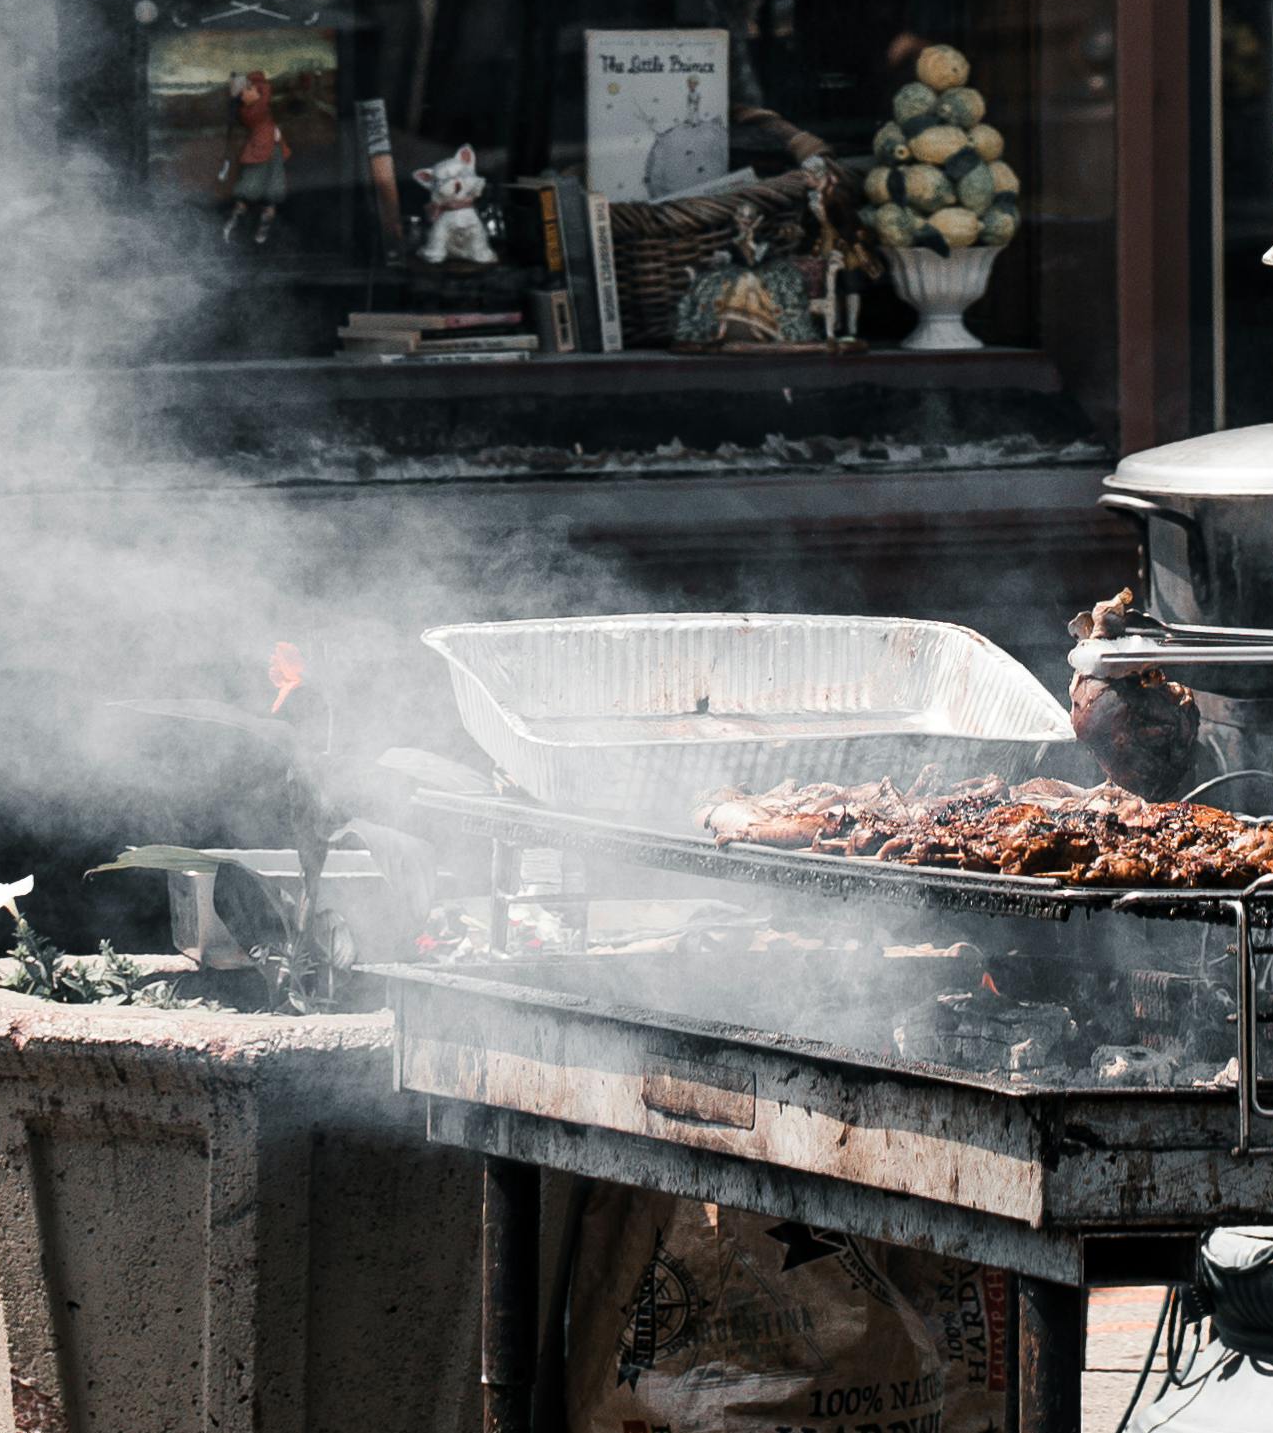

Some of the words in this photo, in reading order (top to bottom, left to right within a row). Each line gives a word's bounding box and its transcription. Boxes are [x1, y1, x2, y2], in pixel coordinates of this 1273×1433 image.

[628, 53, 665, 74] Little
[669, 53, 715, 74] Prince
[810, 1383, 884, 1417] 100%
